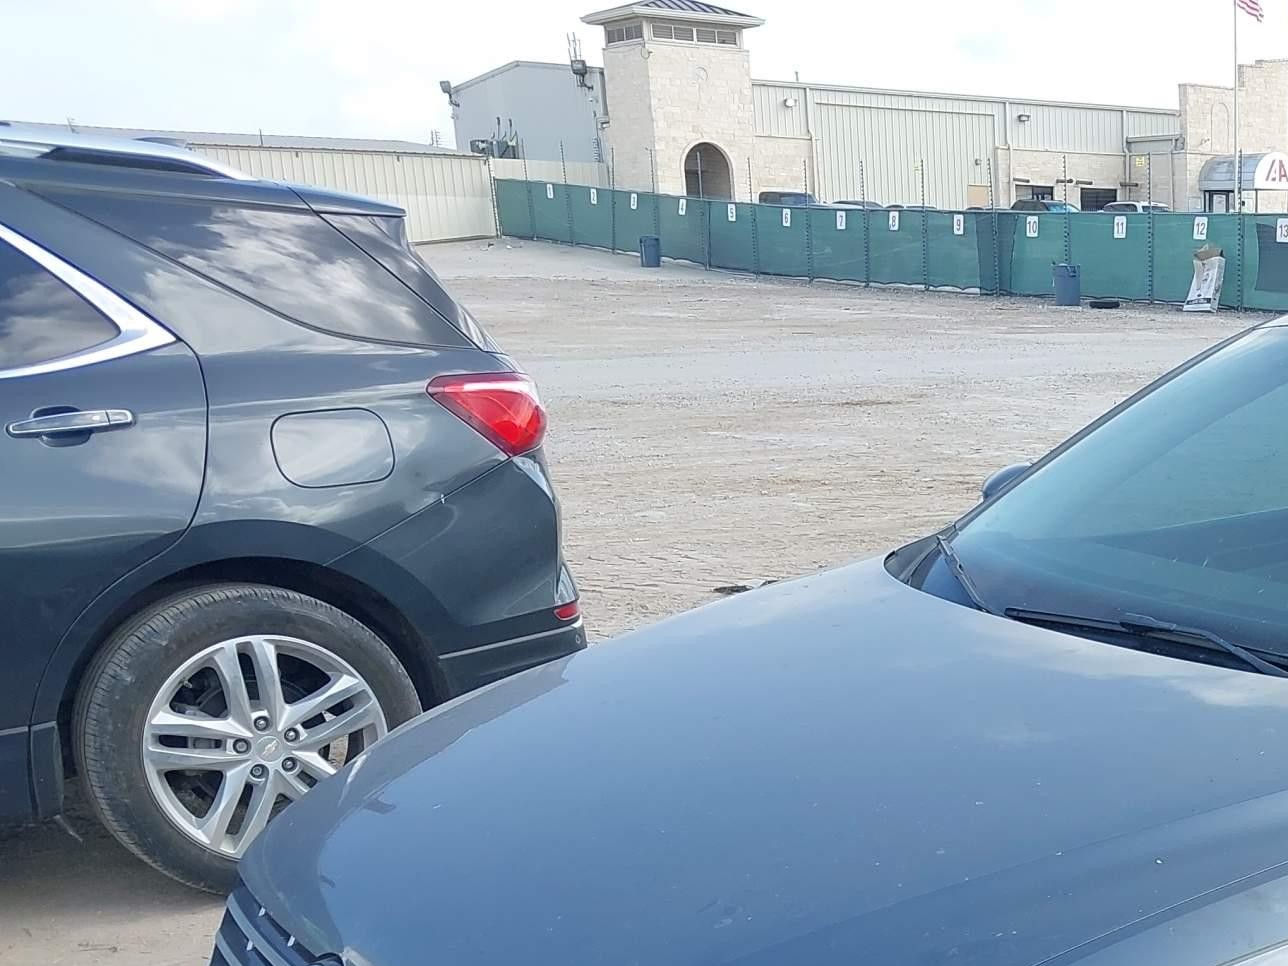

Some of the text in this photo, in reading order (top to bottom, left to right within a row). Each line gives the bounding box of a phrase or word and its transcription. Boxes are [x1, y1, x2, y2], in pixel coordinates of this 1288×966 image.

[1027, 220, 1038, 234] 10
[1116, 221, 1124, 235] 11
[1195, 222, 1206, 236] 12
